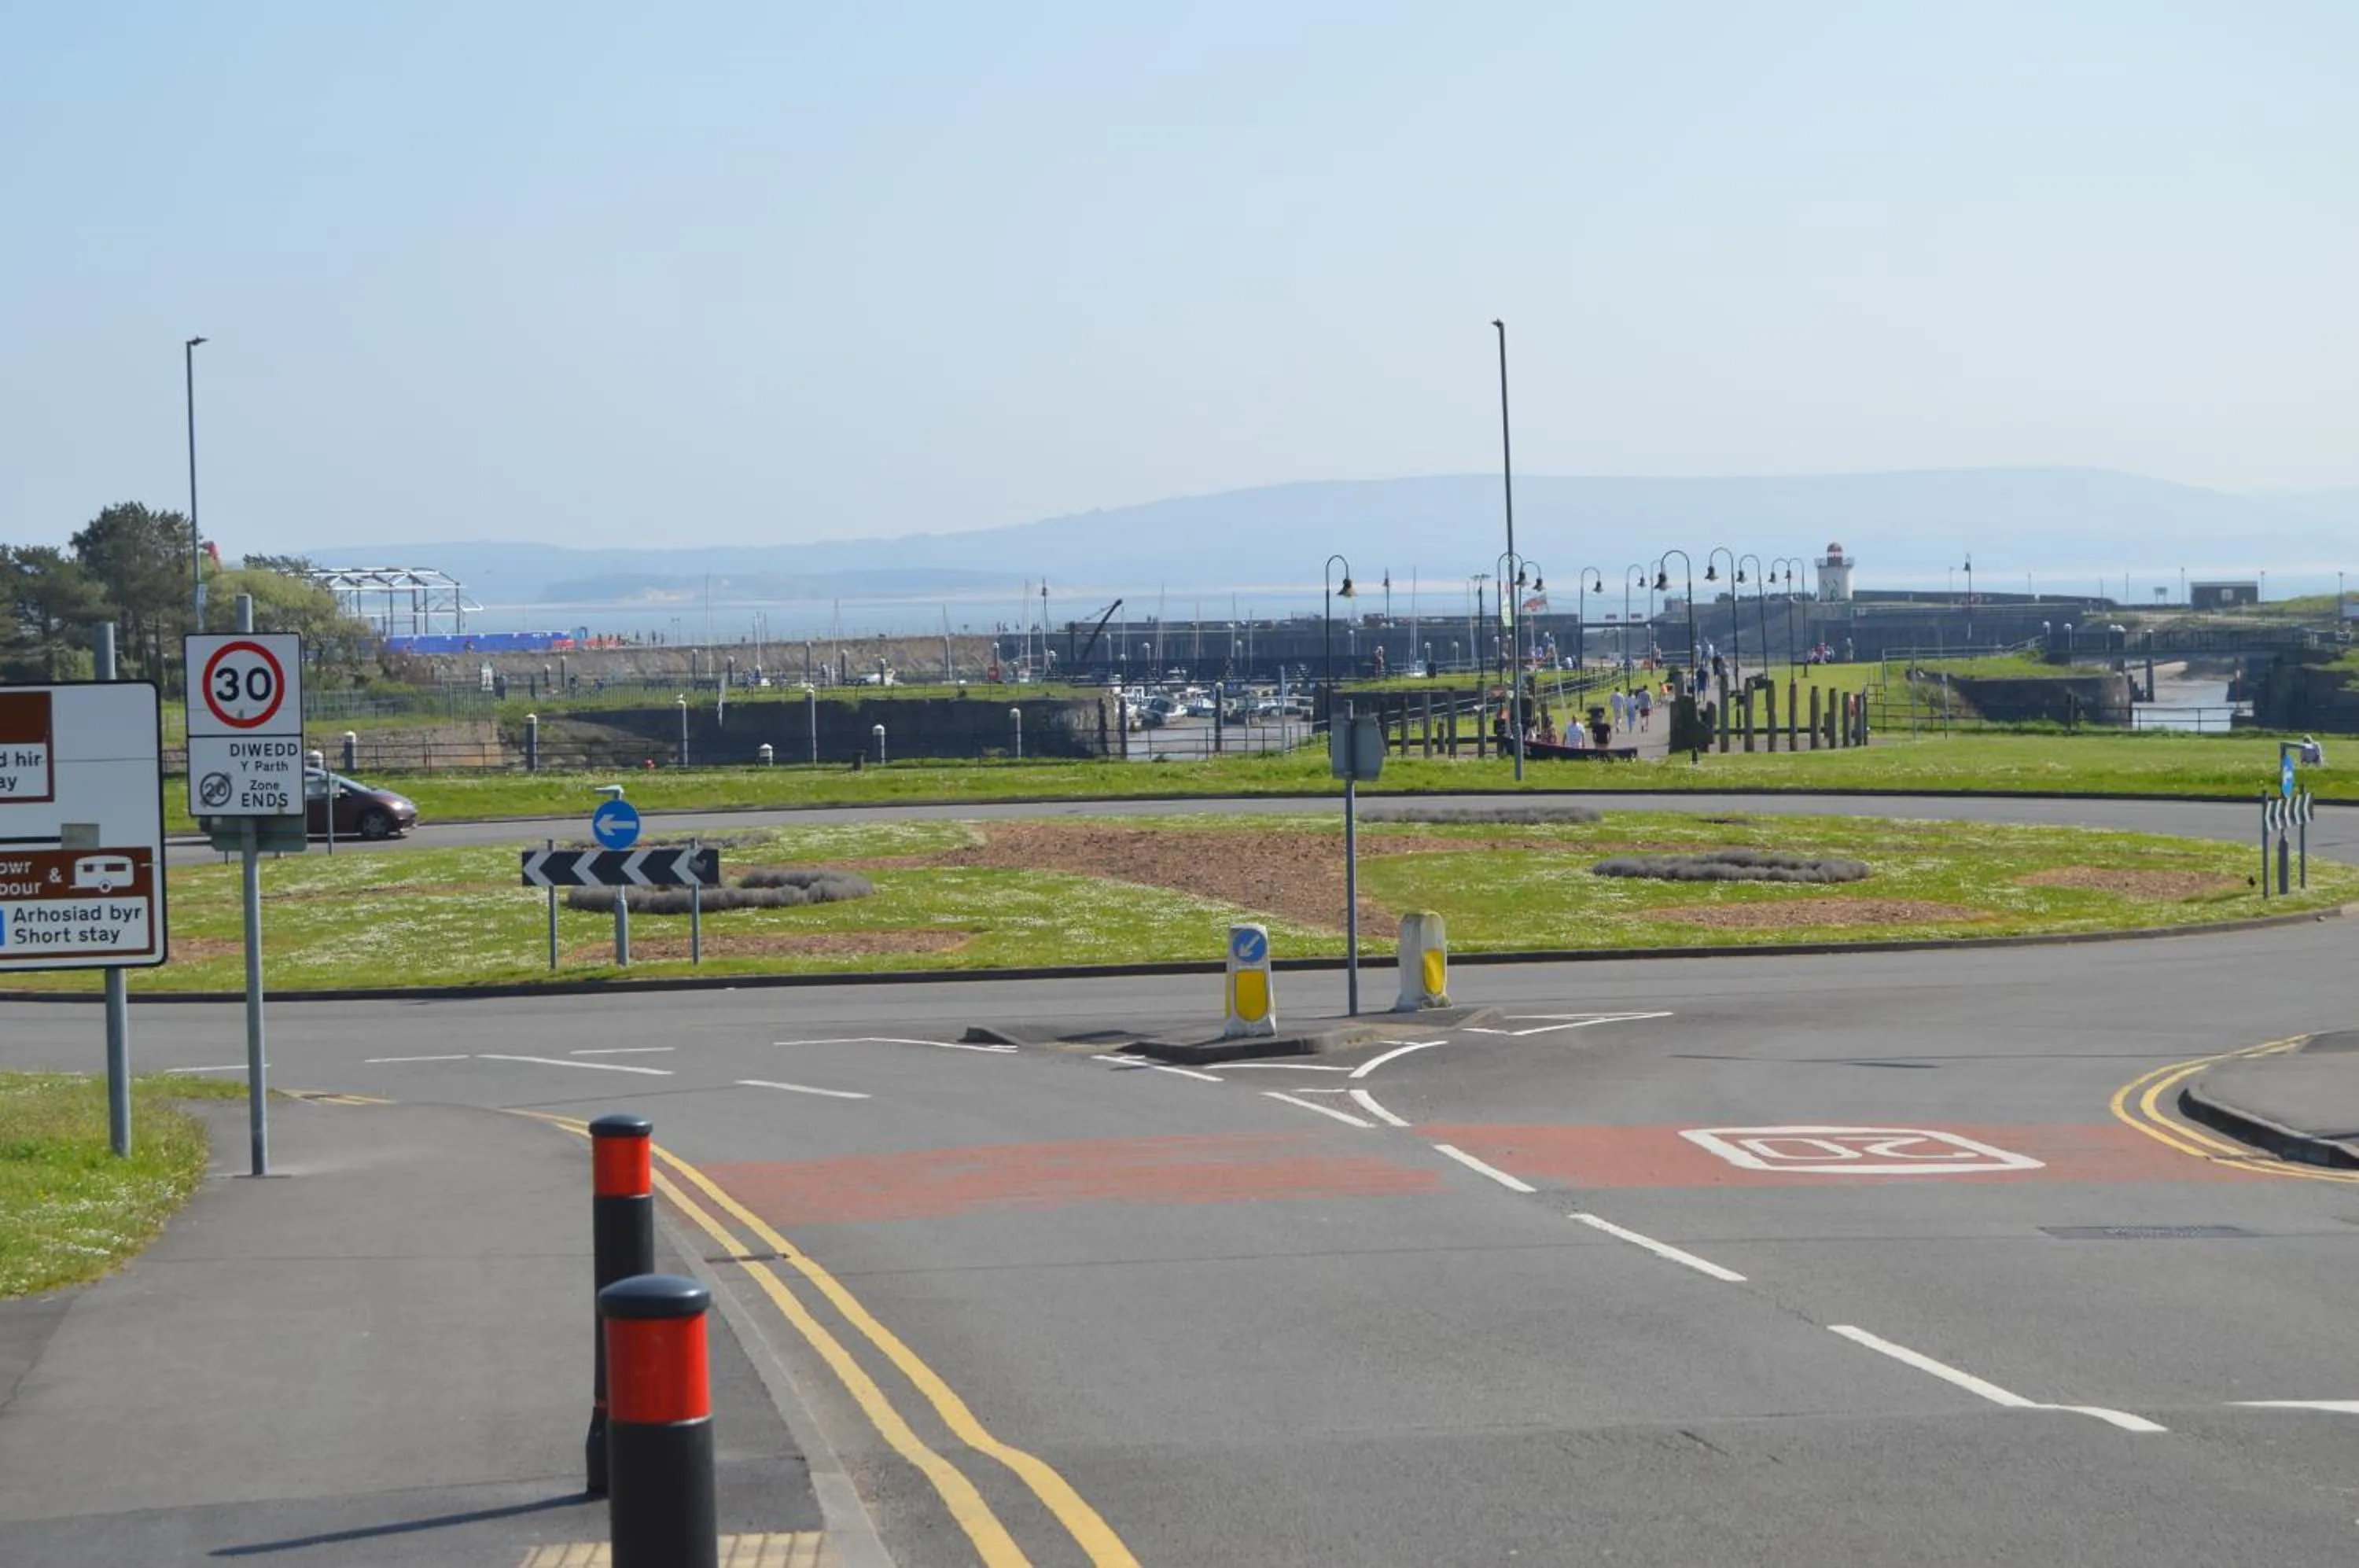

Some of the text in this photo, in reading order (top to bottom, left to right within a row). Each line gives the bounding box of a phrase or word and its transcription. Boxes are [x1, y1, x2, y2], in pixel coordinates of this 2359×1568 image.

[215, 668, 272, 702] 30
[230, 743, 298, 757] DIWEDD
[16, 751, 43, 767] hir
[241, 760, 289, 771] Y Parth
[205, 782, 227, 797] 20
[250, 779, 280, 791] Zone
[241, 793, 289, 808] ENDS
[50, 867, 63, 883] &
[13, 904, 142, 926] Arhosiad byr
[14, 926, 121, 944] Short stay
